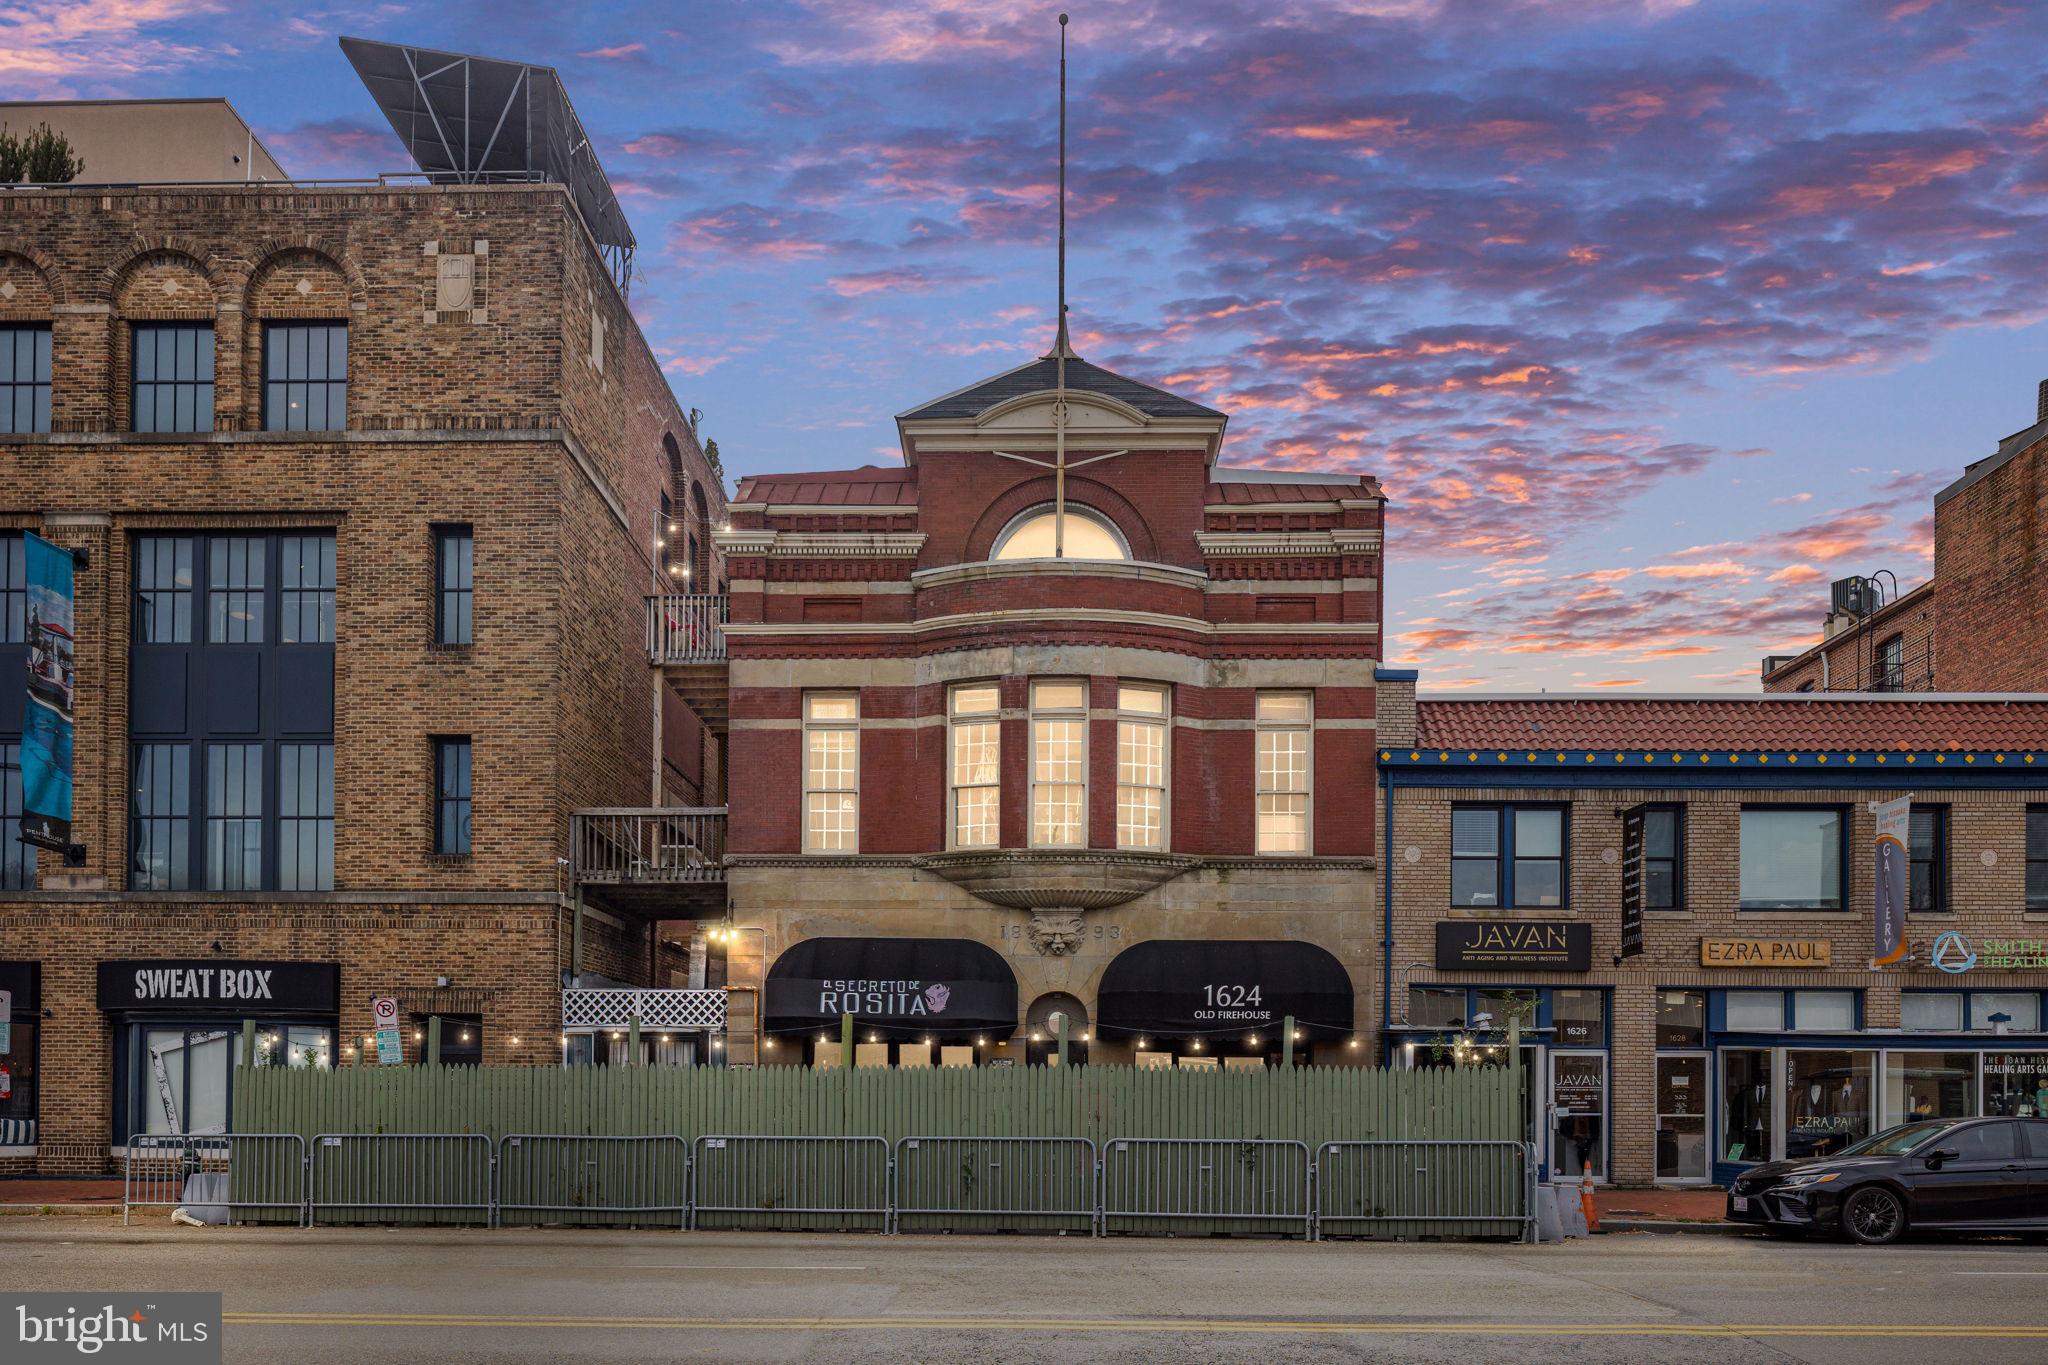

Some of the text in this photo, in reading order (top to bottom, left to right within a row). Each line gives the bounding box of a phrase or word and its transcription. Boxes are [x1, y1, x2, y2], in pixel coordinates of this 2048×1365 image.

[1883, 843, 1892, 952] GALLERY
[1465, 925, 1566, 948] JAVAN
[1708, 943, 1824, 960] EZRA PAUL
[1984, 940, 2042, 954] SMITH
[135, 969, 272, 999] SWEAT BOX
[835, 980, 905, 992] SECRETO
[908, 980, 920, 990] DE
[1203, 984, 1262, 1007] 1624
[820, 992, 926, 1015] ROSITA
[1194, 1010, 1271, 1020] OLD FIREHOUSE
[1567, 1027, 1587, 1035] 1626
[1670, 1033, 1686, 1042] 1628
[1984, 1056, 1999, 1064] THE
[1984, 1065, 2015, 1074] HEALING
[2016, 1065, 2035, 1074] ARTS
[1555, 1075, 1602, 1086] JAVAN
[1796, 1116, 1829, 1128] EZRA
